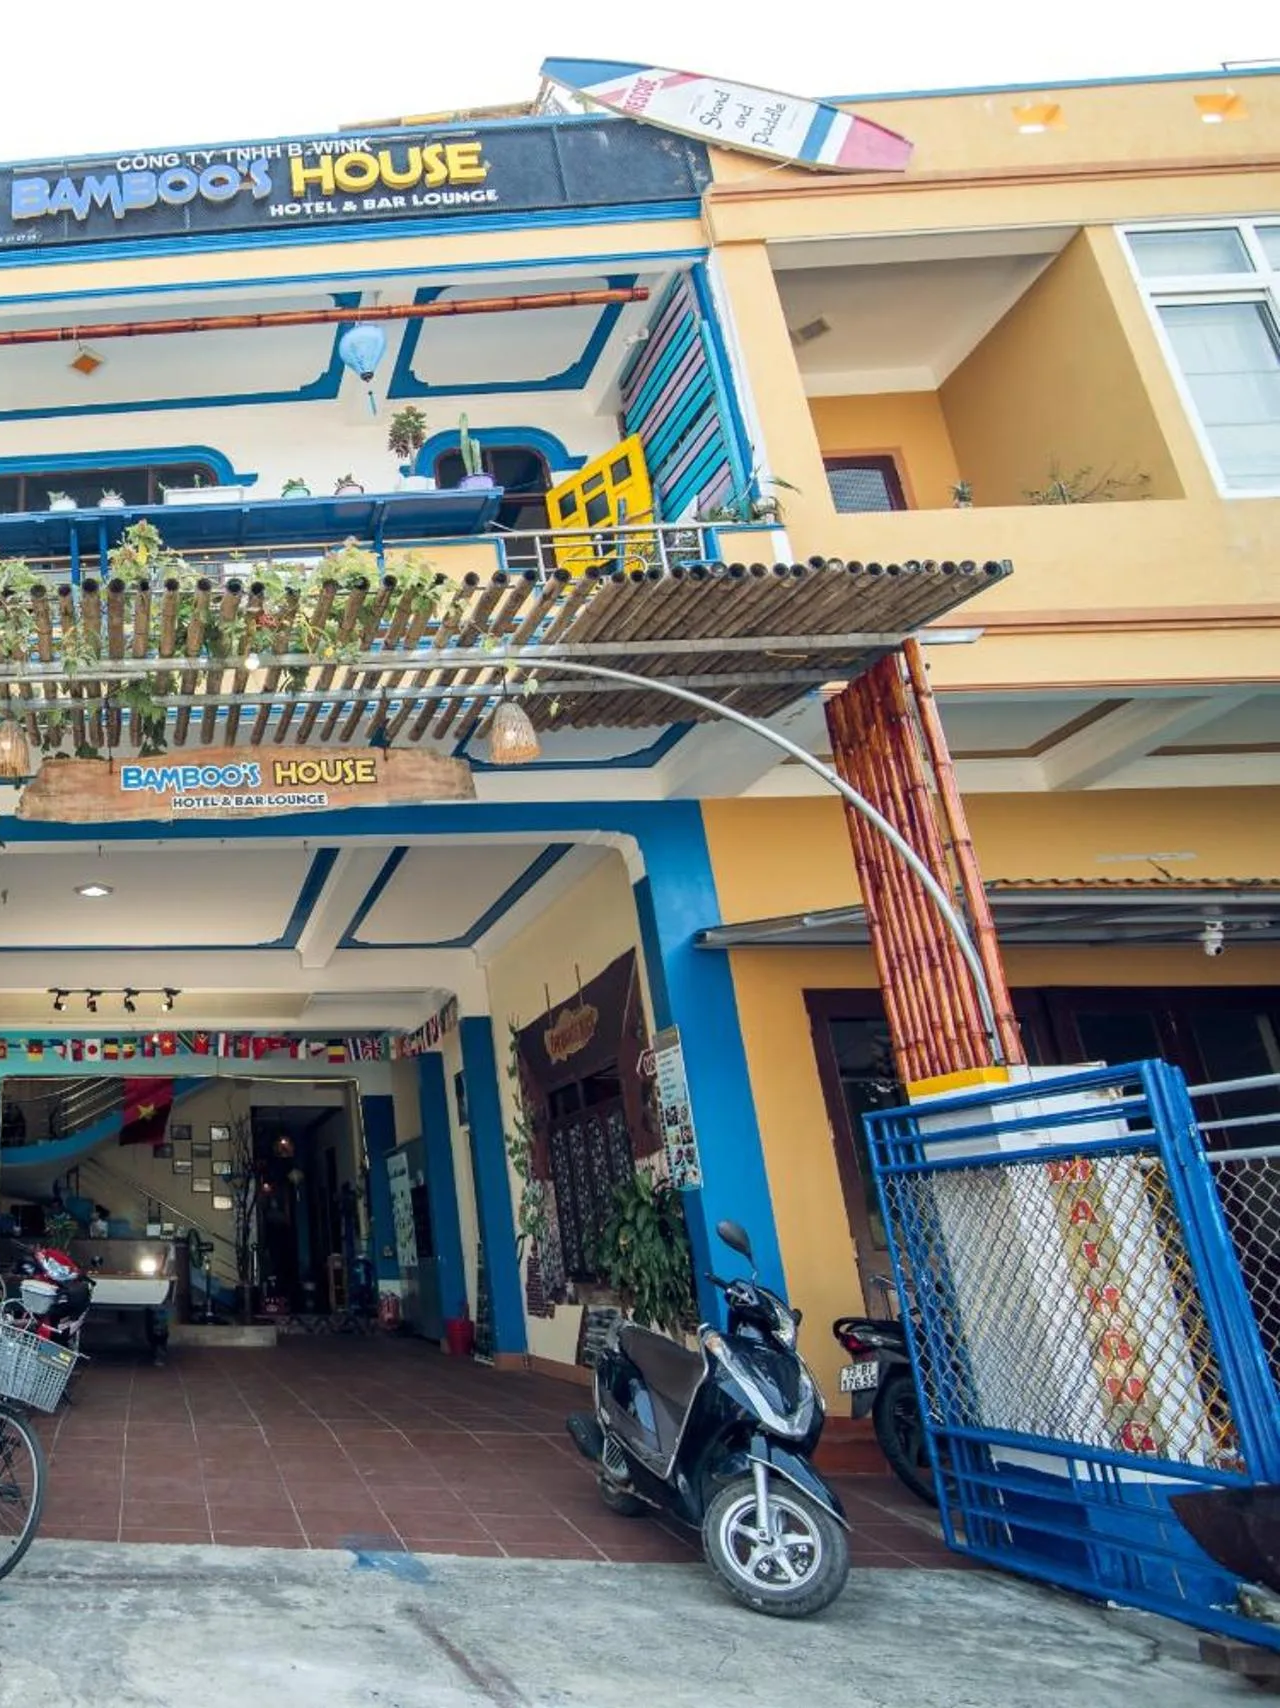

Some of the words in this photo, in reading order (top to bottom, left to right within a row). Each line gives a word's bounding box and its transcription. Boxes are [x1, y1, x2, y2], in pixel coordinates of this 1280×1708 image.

[699, 89, 730, 130] Stand
[735, 103, 754, 128] and
[186, 151, 214, 166] TY
[222, 144, 281, 163] TNHH
[11, 159, 271, 220] BAMBOO'S
[290, 143, 488, 198] HOUSE
[271, 202, 338, 217] HOTEL
[344, 199, 357, 212] &
[363, 195, 406, 210] BAR
[412, 189, 499, 206] LOUNGE
[121, 763, 261, 792] BAMBOO'S
[273, 760, 376, 786] HOUSE
[173, 797, 219, 808] HOTEL
[222, 797, 231, 807] &
[234, 796, 265, 807] BAR
[267, 794, 326, 807] LOUNGE
